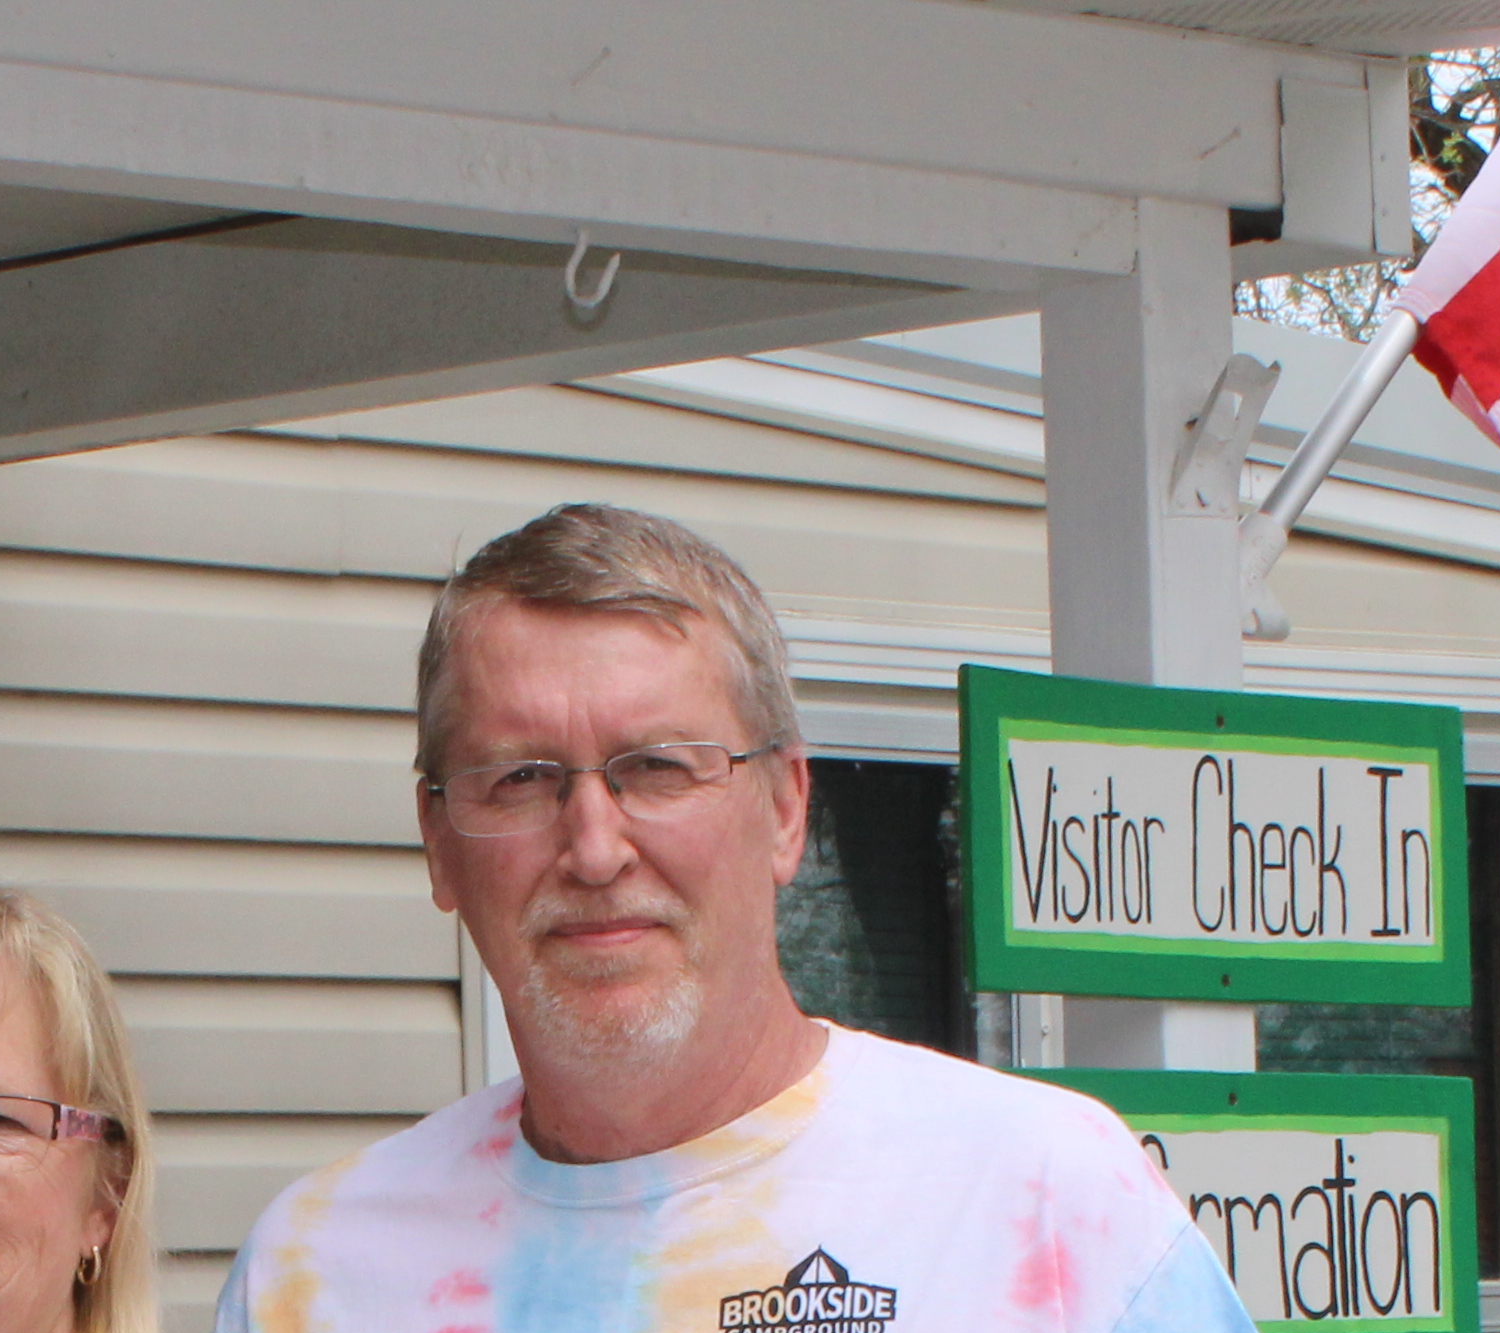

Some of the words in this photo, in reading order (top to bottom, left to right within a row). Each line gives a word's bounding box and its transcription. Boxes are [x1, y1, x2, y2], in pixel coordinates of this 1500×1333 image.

[1007, 757, 1166, 926] Visitor
[1190, 752, 1348, 938] Check
[1366, 764, 1432, 938] In
[721, 1285, 894, 1327] BROOKSIDE
